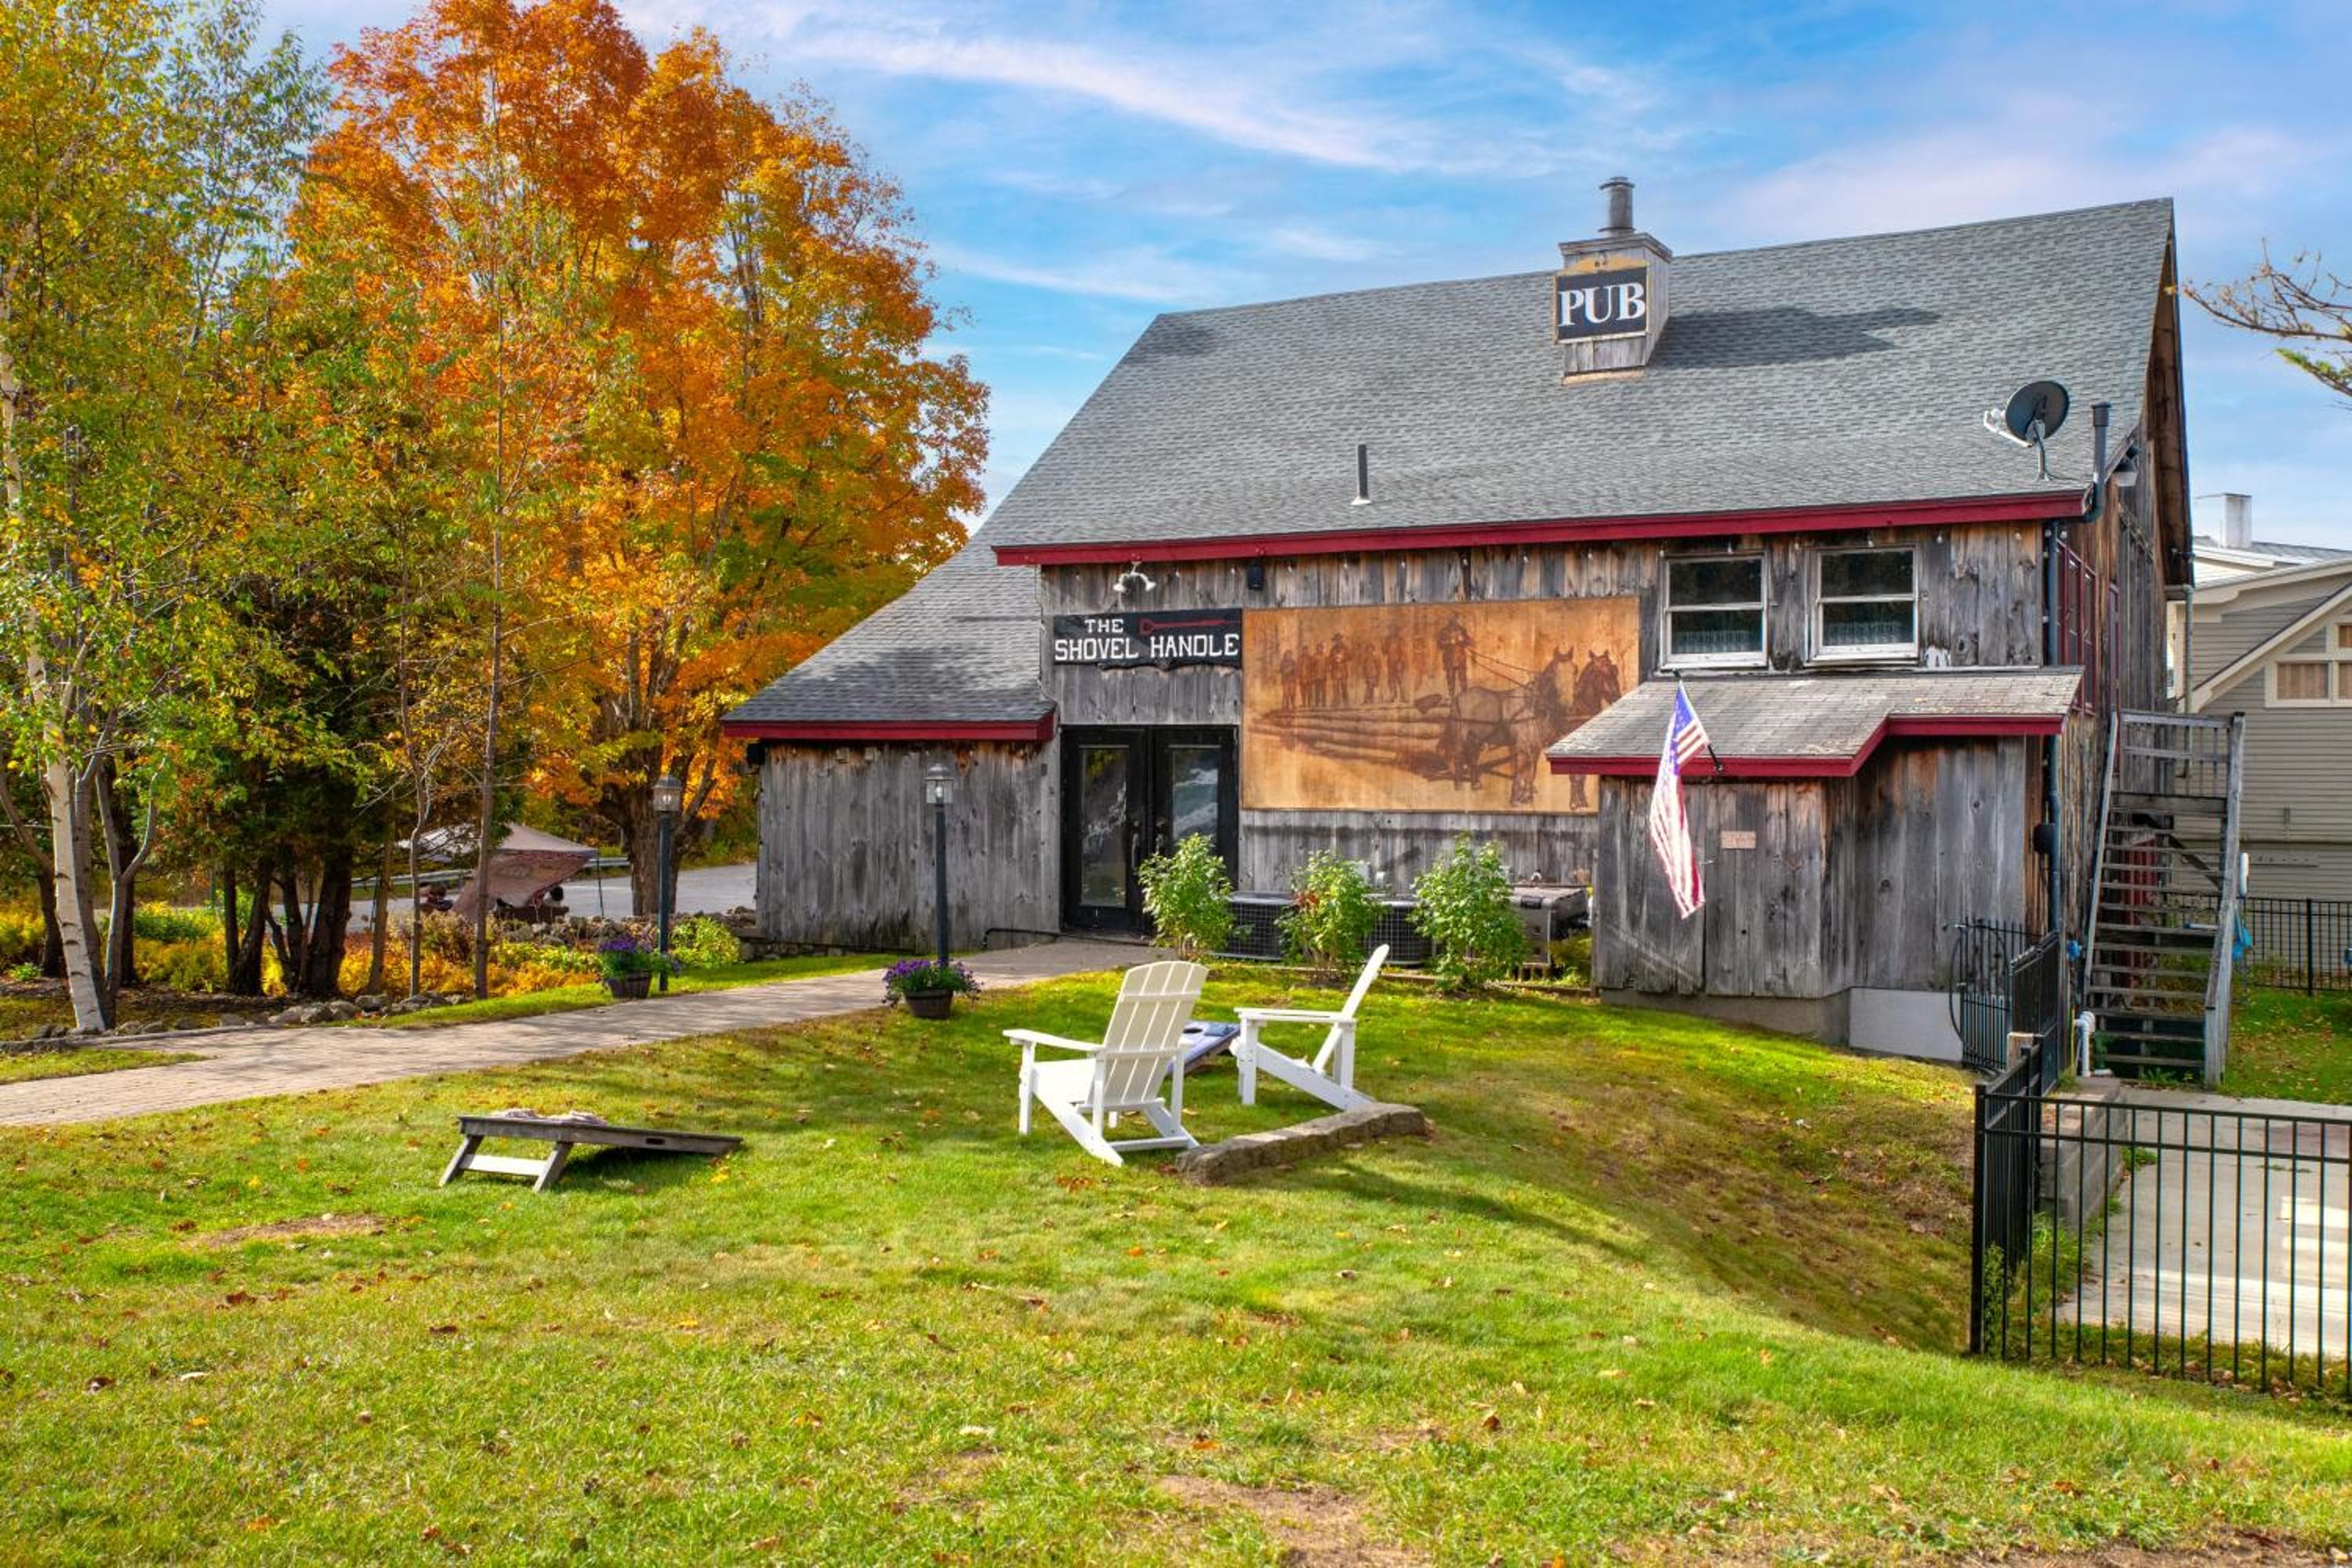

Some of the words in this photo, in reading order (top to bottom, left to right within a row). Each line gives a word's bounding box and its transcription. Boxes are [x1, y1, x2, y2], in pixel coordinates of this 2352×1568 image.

[1558, 282, 1646, 326] PUB
[1084, 619, 1124, 633] THE
[1054, 637, 1139, 660] SHOVEL
[1150, 633, 1240, 658] HANDLE
